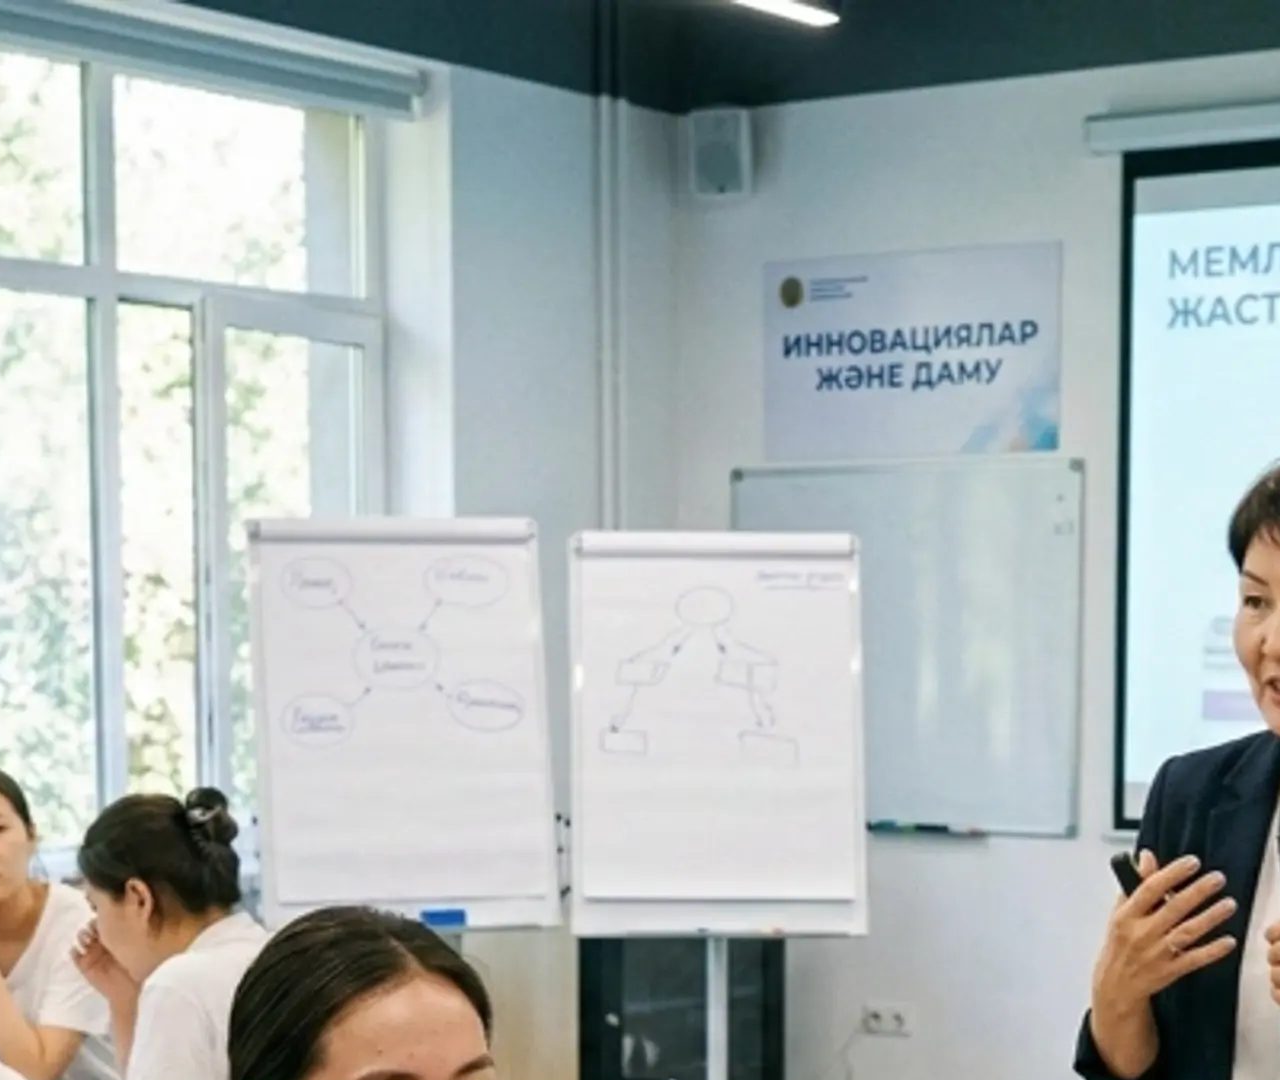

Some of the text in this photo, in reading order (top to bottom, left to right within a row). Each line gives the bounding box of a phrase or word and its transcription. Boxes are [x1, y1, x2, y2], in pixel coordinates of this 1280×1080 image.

[781, 320, 1039, 360] ИННОВАЦИЯЛАР
[815, 358, 1004, 392] ЖӘНЕ ДАМУ
